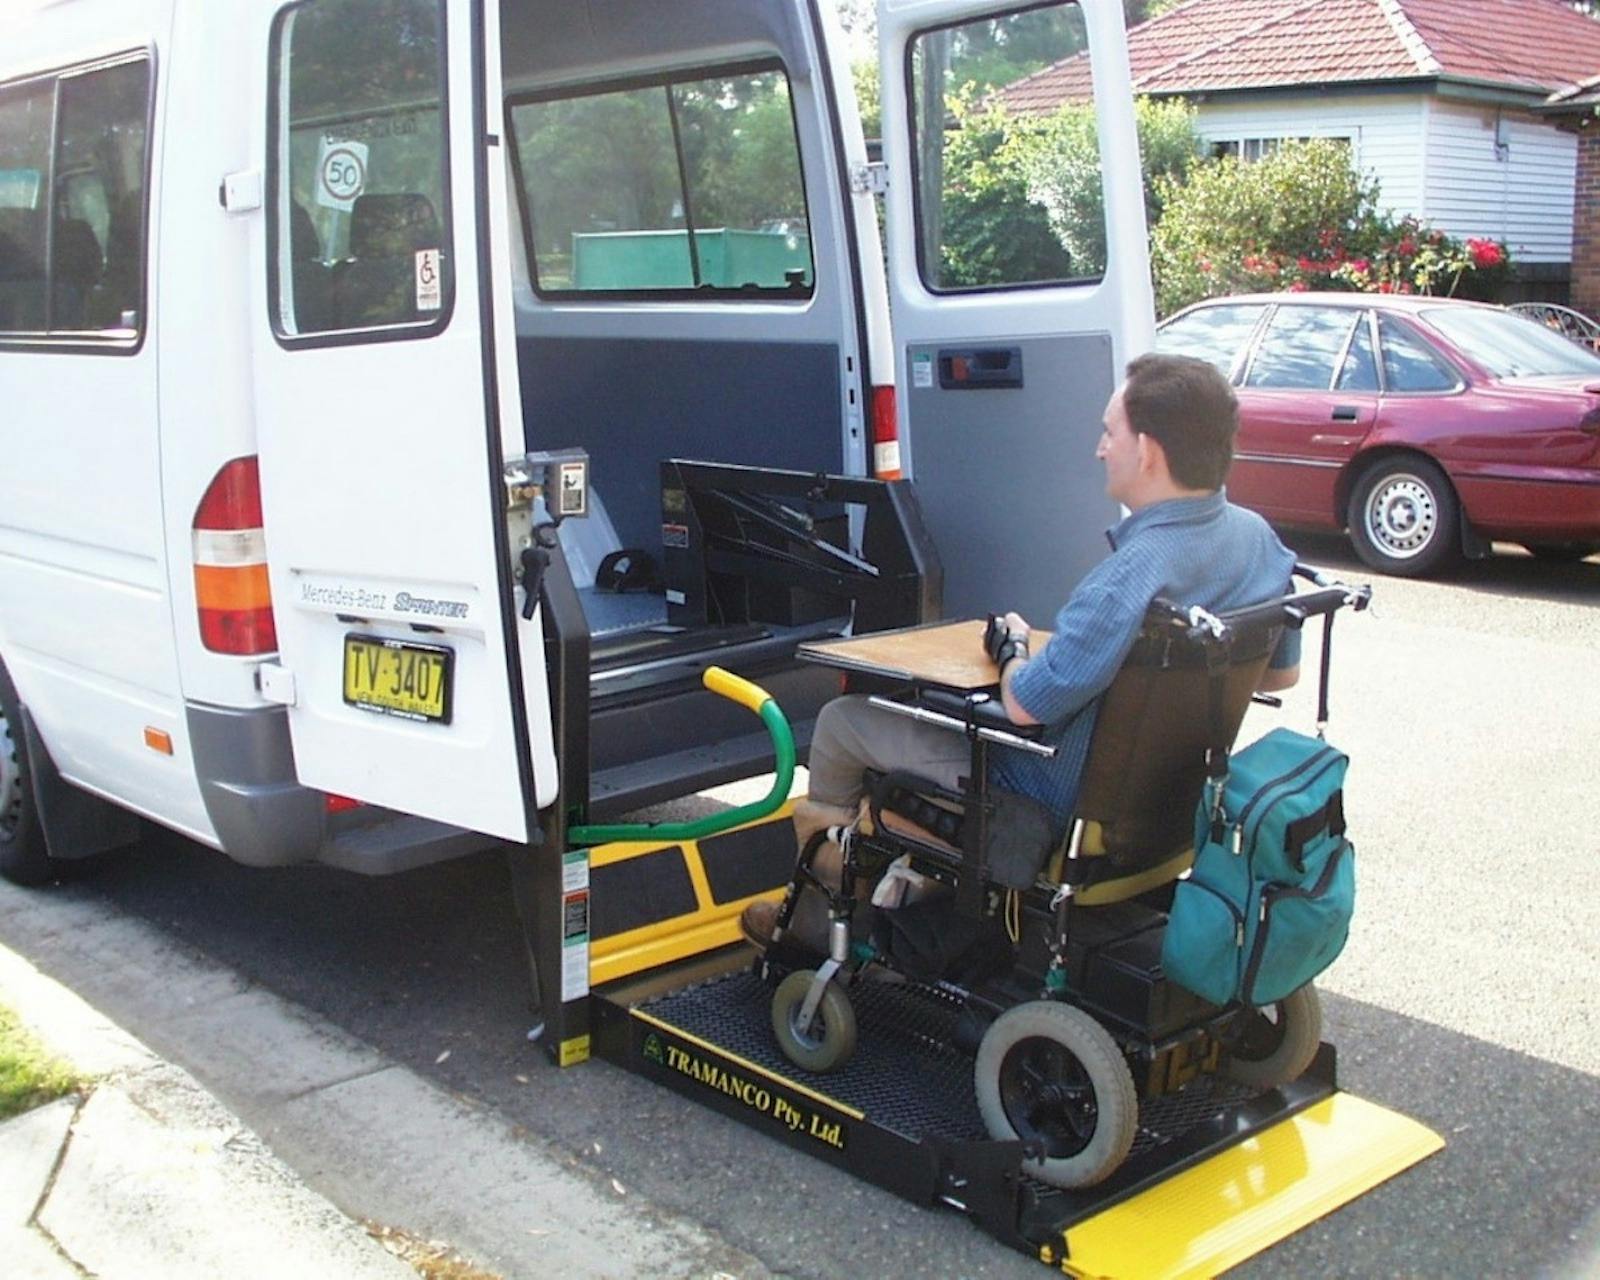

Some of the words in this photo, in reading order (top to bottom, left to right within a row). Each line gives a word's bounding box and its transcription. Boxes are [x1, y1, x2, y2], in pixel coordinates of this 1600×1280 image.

[330, 161, 357, 186] 50
[302, 583, 387, 611] Mercedes-Benz
[667, 1046, 771, 1112] TRAMANCO
[773, 1098, 805, 1131] Pty.
[810, 1115, 844, 1148] Ltd.
